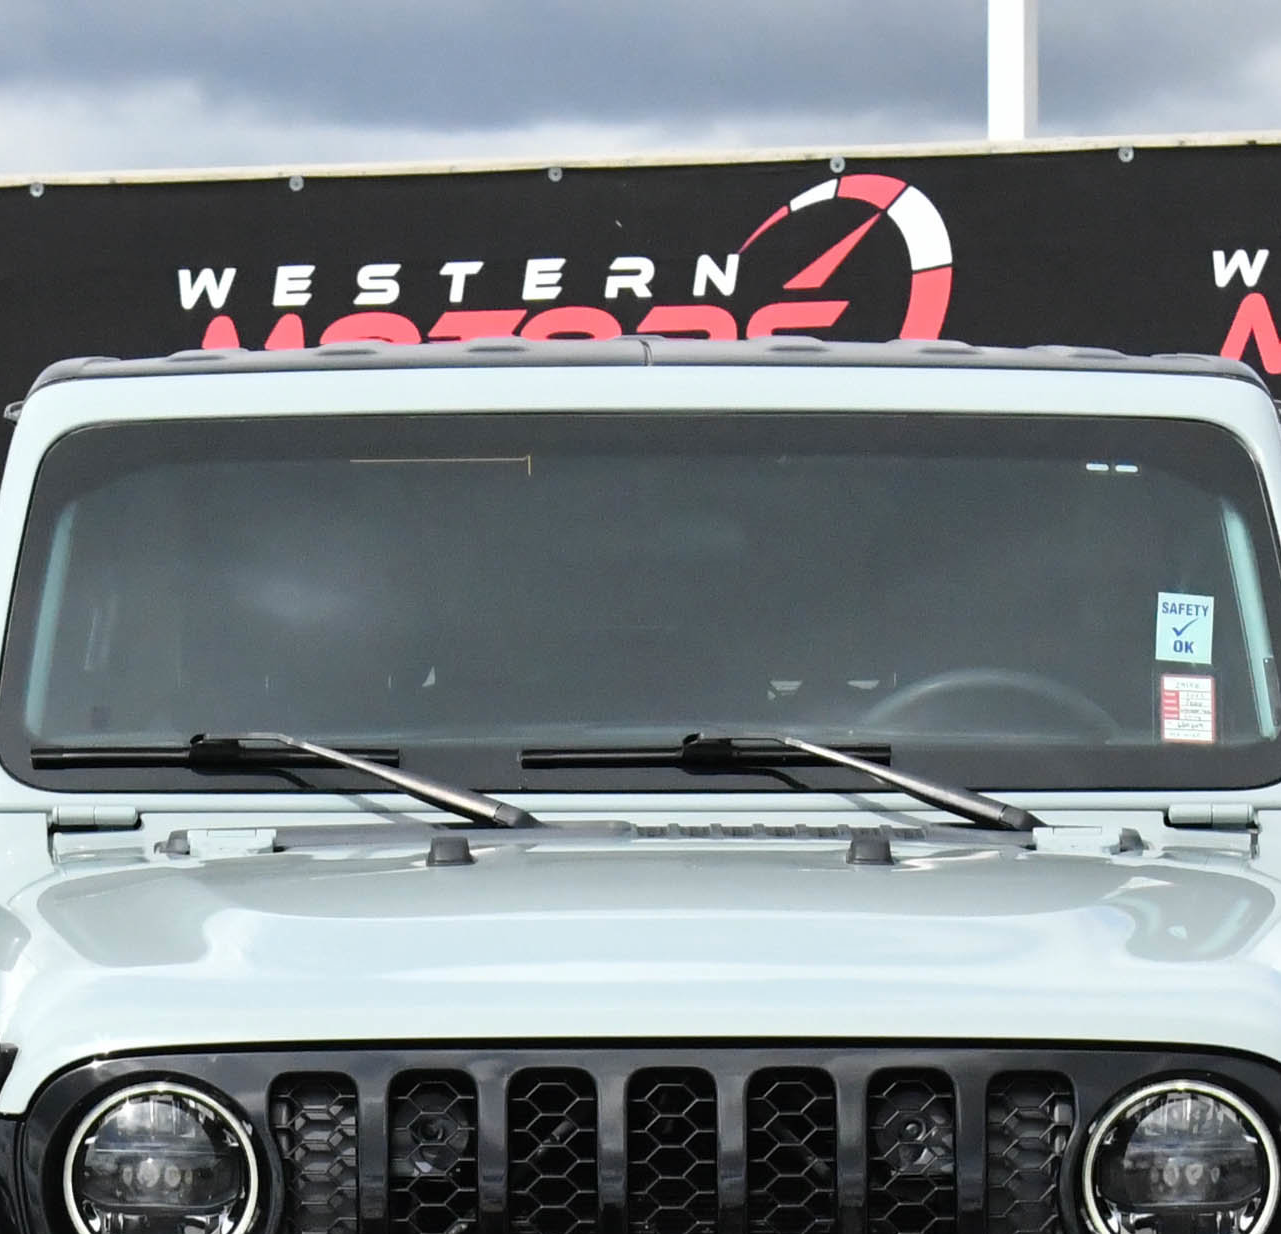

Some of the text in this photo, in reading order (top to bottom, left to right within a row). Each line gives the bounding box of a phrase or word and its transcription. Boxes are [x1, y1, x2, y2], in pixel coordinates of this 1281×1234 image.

[178, 254, 739, 309] WESTERN
[1161, 602, 1209, 618] SAFETY
[1173, 640, 1194, 654] OK
